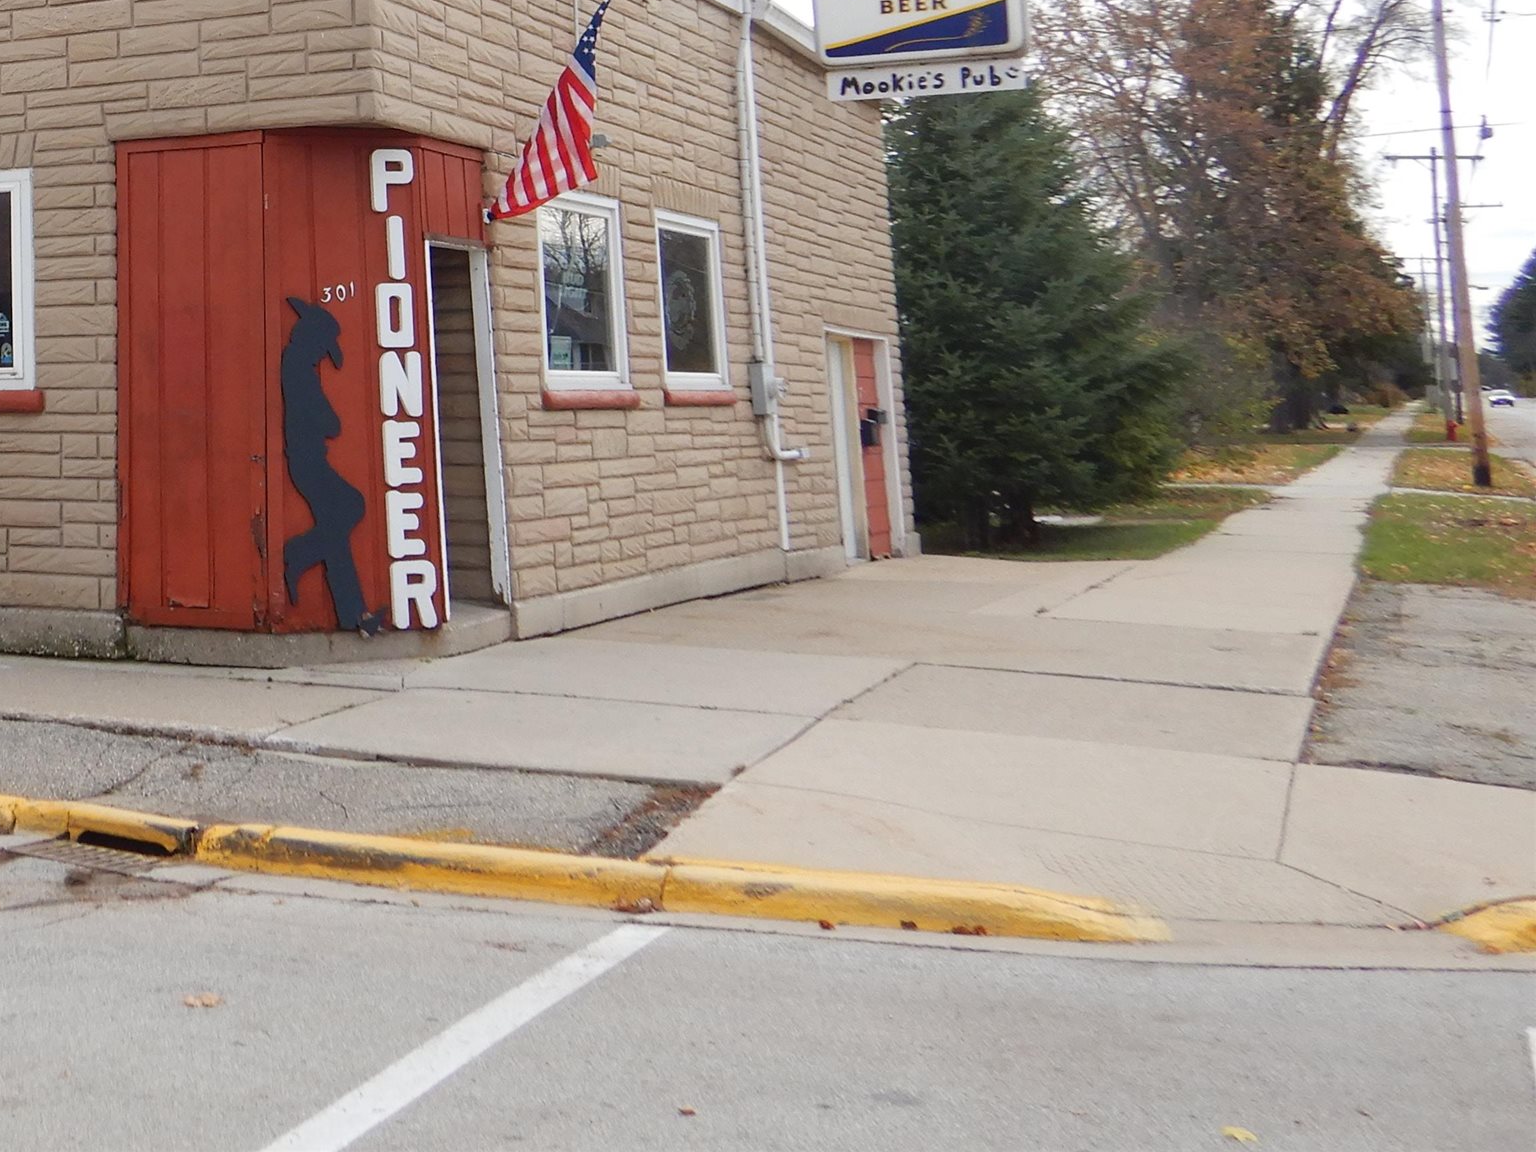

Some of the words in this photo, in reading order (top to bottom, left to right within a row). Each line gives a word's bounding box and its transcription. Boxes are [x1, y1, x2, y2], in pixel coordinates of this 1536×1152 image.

[840, 70, 945, 96] Mookie's
[961, 65, 1002, 89] Pub
[319, 280, 355, 304] 301
[369, 148, 439, 631] PIONEER
